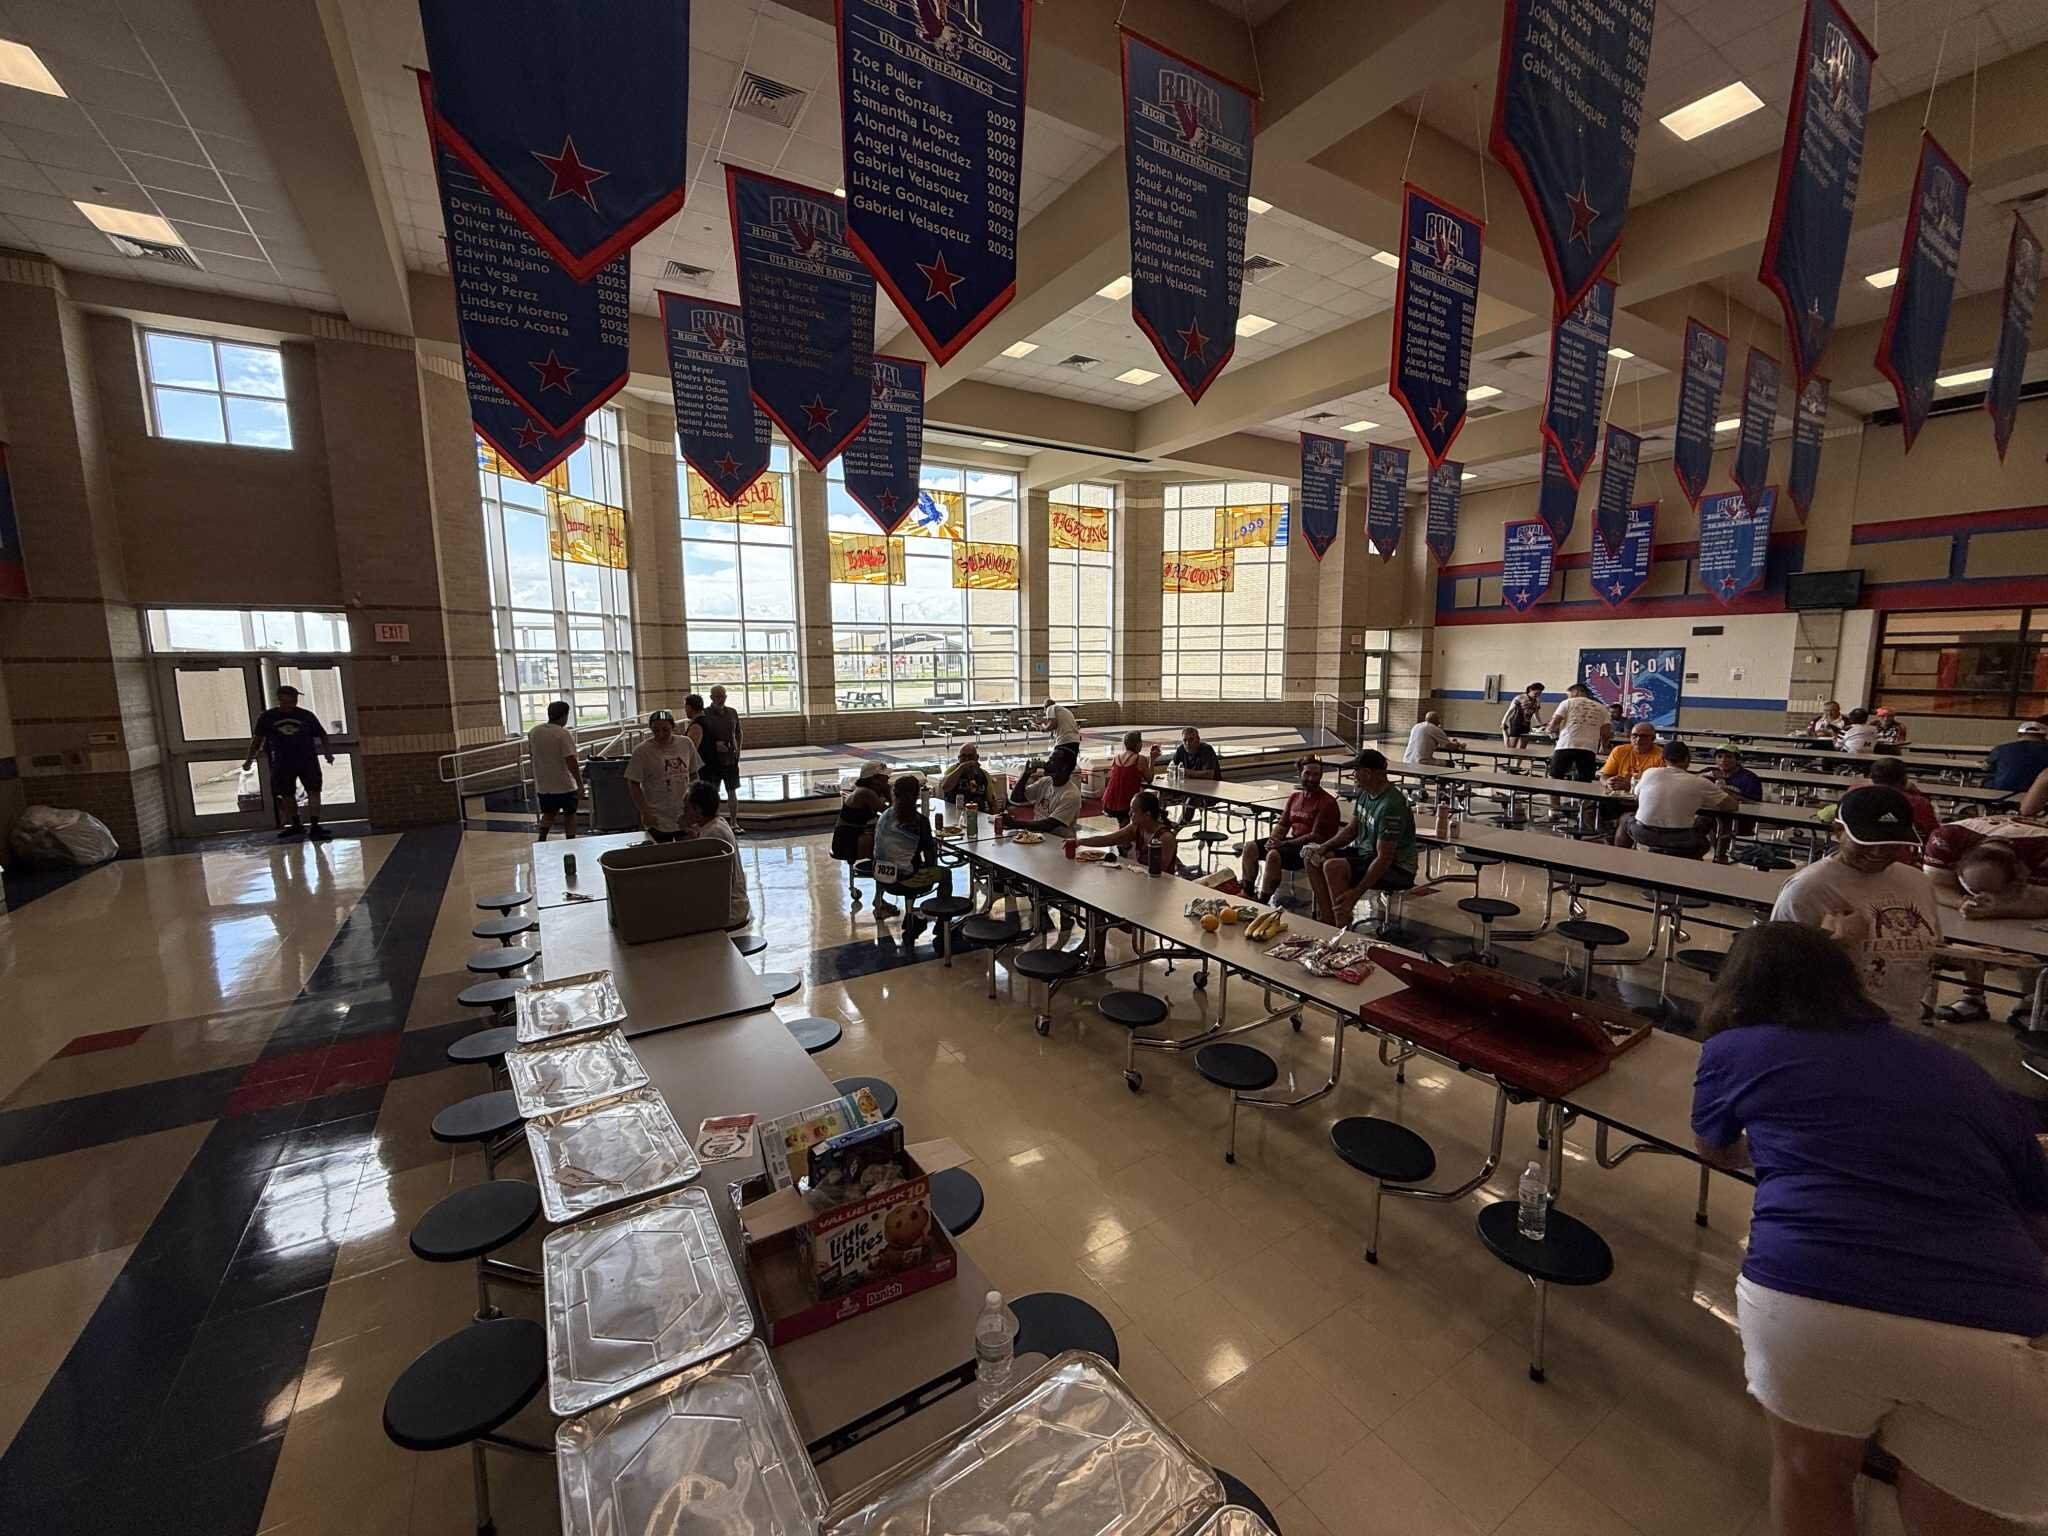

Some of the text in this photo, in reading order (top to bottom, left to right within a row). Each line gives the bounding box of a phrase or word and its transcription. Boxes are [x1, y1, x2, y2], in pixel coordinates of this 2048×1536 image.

[879, 31, 994, 96] UIL MATHEMATICS
[967, 37, 1012, 70] SCHOOL
[1525, 24, 1553, 54] Jade
[1553, 43, 1583, 81] Lopez
[852, 50, 923, 90] Zoe Buller
[852, 68, 954, 125] Litzie Gonzalez
[1522, 52, 1562, 92] Gabriel
[1564, 80, 1608, 129] Velasquez
[853, 90, 961, 147] Samantha Lopez
[986, 110, 1017, 131] 2022
[1142, 104, 1242, 156] HIGH SCHOOL
[853, 112, 972, 169] Alondra Melendez
[986, 129, 1017, 150] 2022
[853, 131, 961, 184] Angel Velasquez
[986, 146, 1017, 168] 2022
[1153, 138, 1232, 178] UIL MATHEMATICS
[853, 151, 970, 204] Gabriel Velasquez
[986, 165, 1016, 186] 2022
[1135, 155, 1208, 193] Stephen Morgan
[853, 171, 955, 219] Litzie Gonzalez
[986, 183, 1016, 204] 2022
[1135, 189, 1199, 219] Shauna Odum
[1164, 185, 1193, 202] Alfaro
[451, 198, 491, 217] Devin
[853, 195, 972, 245] Gabriel Velasqeuz
[986, 200, 1016, 222] 2022
[1135, 205, 1183, 229] Zoe Buller
[453, 214, 495, 232] Oliver
[751, 225, 779, 241] HIGH
[986, 219, 1015, 241] 2023
[1135, 221, 1207, 252] Samantha Lopez
[1426, 212, 1464, 257] ROYAL
[454, 230, 516, 252] Christian
[986, 239, 1014, 261] 2023
[1134, 238, 1215, 269] Alondra Melendez
[455, 246, 550, 275] Edwin Majano
[457, 261, 519, 283] Izic Vega
[769, 253, 853, 281] UIL REGION BAND
[1134, 251, 1201, 279] Katia Mendoza
[460, 280, 539, 302] Andy Perez
[596, 274, 627, 289] 2025
[1134, 268, 1207, 297] Angel Velasquez
[460, 293, 568, 323] Lindsey Moreno
[597, 290, 628, 304] 2025
[462, 310, 569, 336] Eduardo Acosta
[598, 304, 628, 319] 2025
[600, 318, 629, 334] 2025
[674, 362, 690, 371] Erin
[1051, 511, 1108, 545] FIGHTING
[1517, 525, 1544, 537] ROYAL
[957, 555, 1016, 577] SCHOOL
[1163, 561, 1232, 585] FALCONS
[381, 625, 404, 640] EXIT
[1585, 656, 1676, 678] FALCON
[818, 1182, 926, 1229] VALUE PACK 10
[829, 1222, 870, 1262] Little
[843, 1230, 884, 1268] Bites
[867, 1283, 903, 1306] Danish
